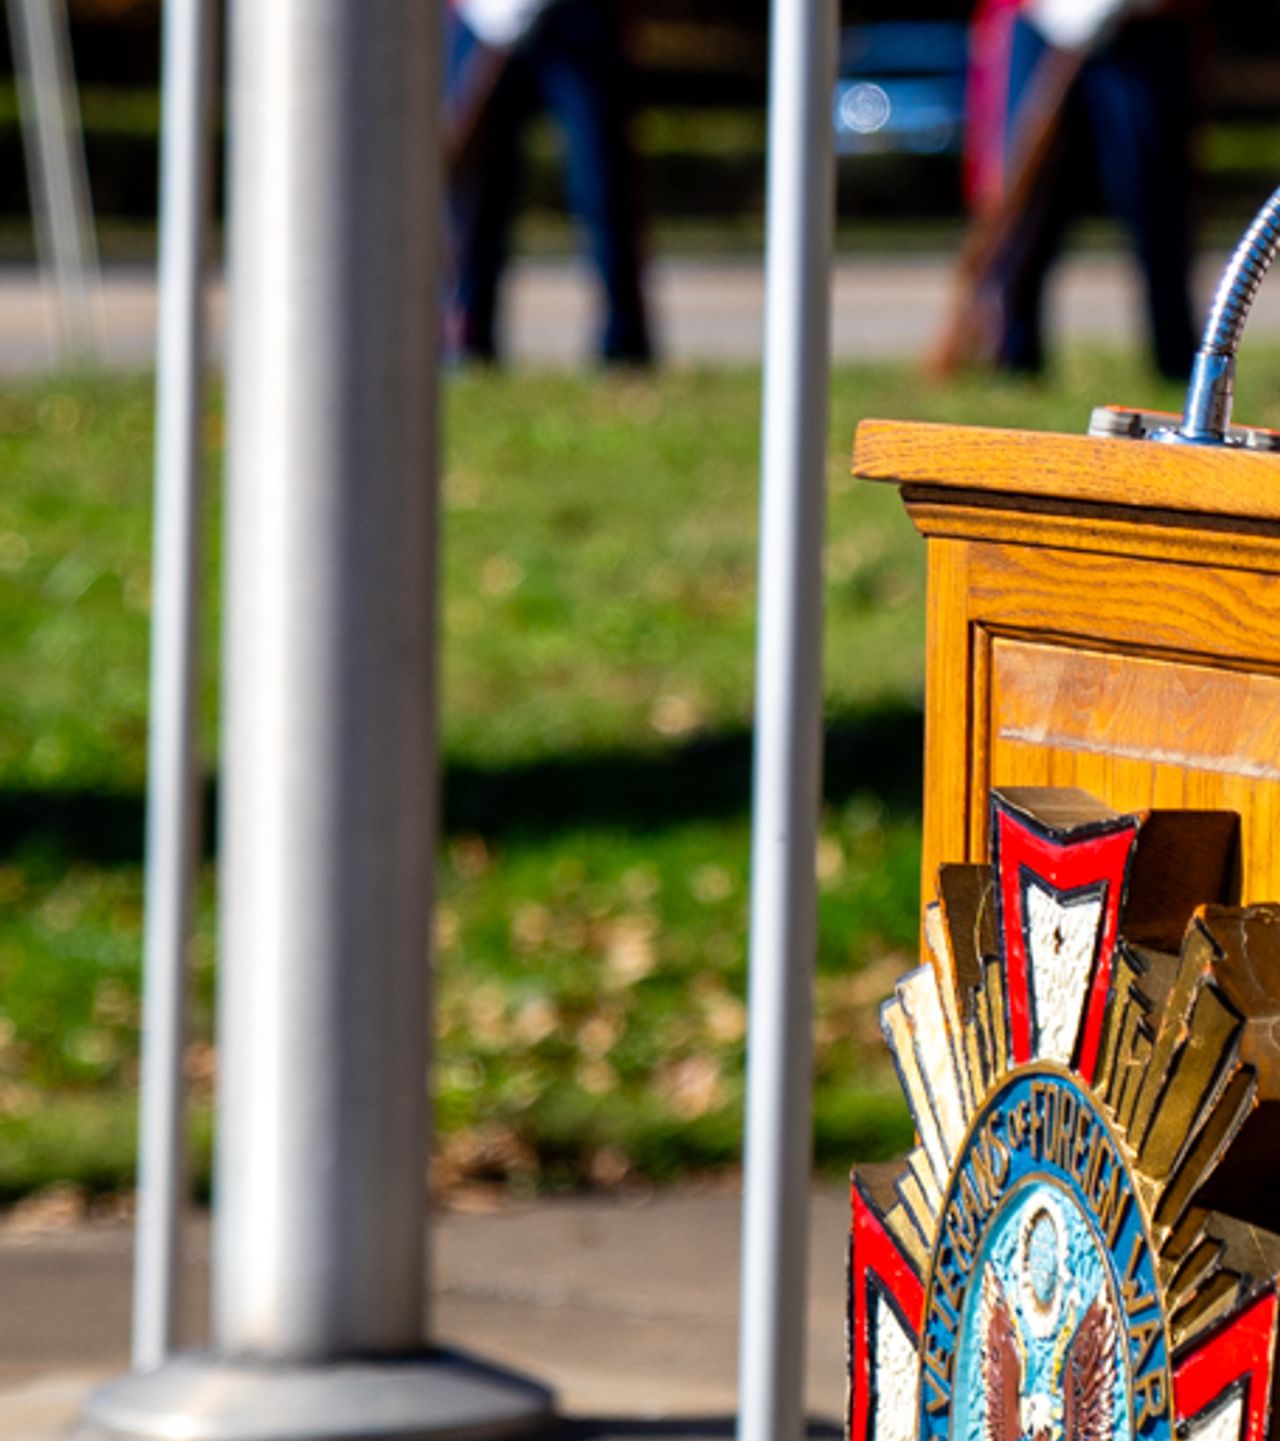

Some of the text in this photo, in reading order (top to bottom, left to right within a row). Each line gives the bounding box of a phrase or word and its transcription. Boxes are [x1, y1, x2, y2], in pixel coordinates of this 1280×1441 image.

[924, 1110, 1010, 1414] VETERANS
[1007, 1100, 1027, 1147] OF
[1030, 1079, 1130, 1250] FOREIGN
